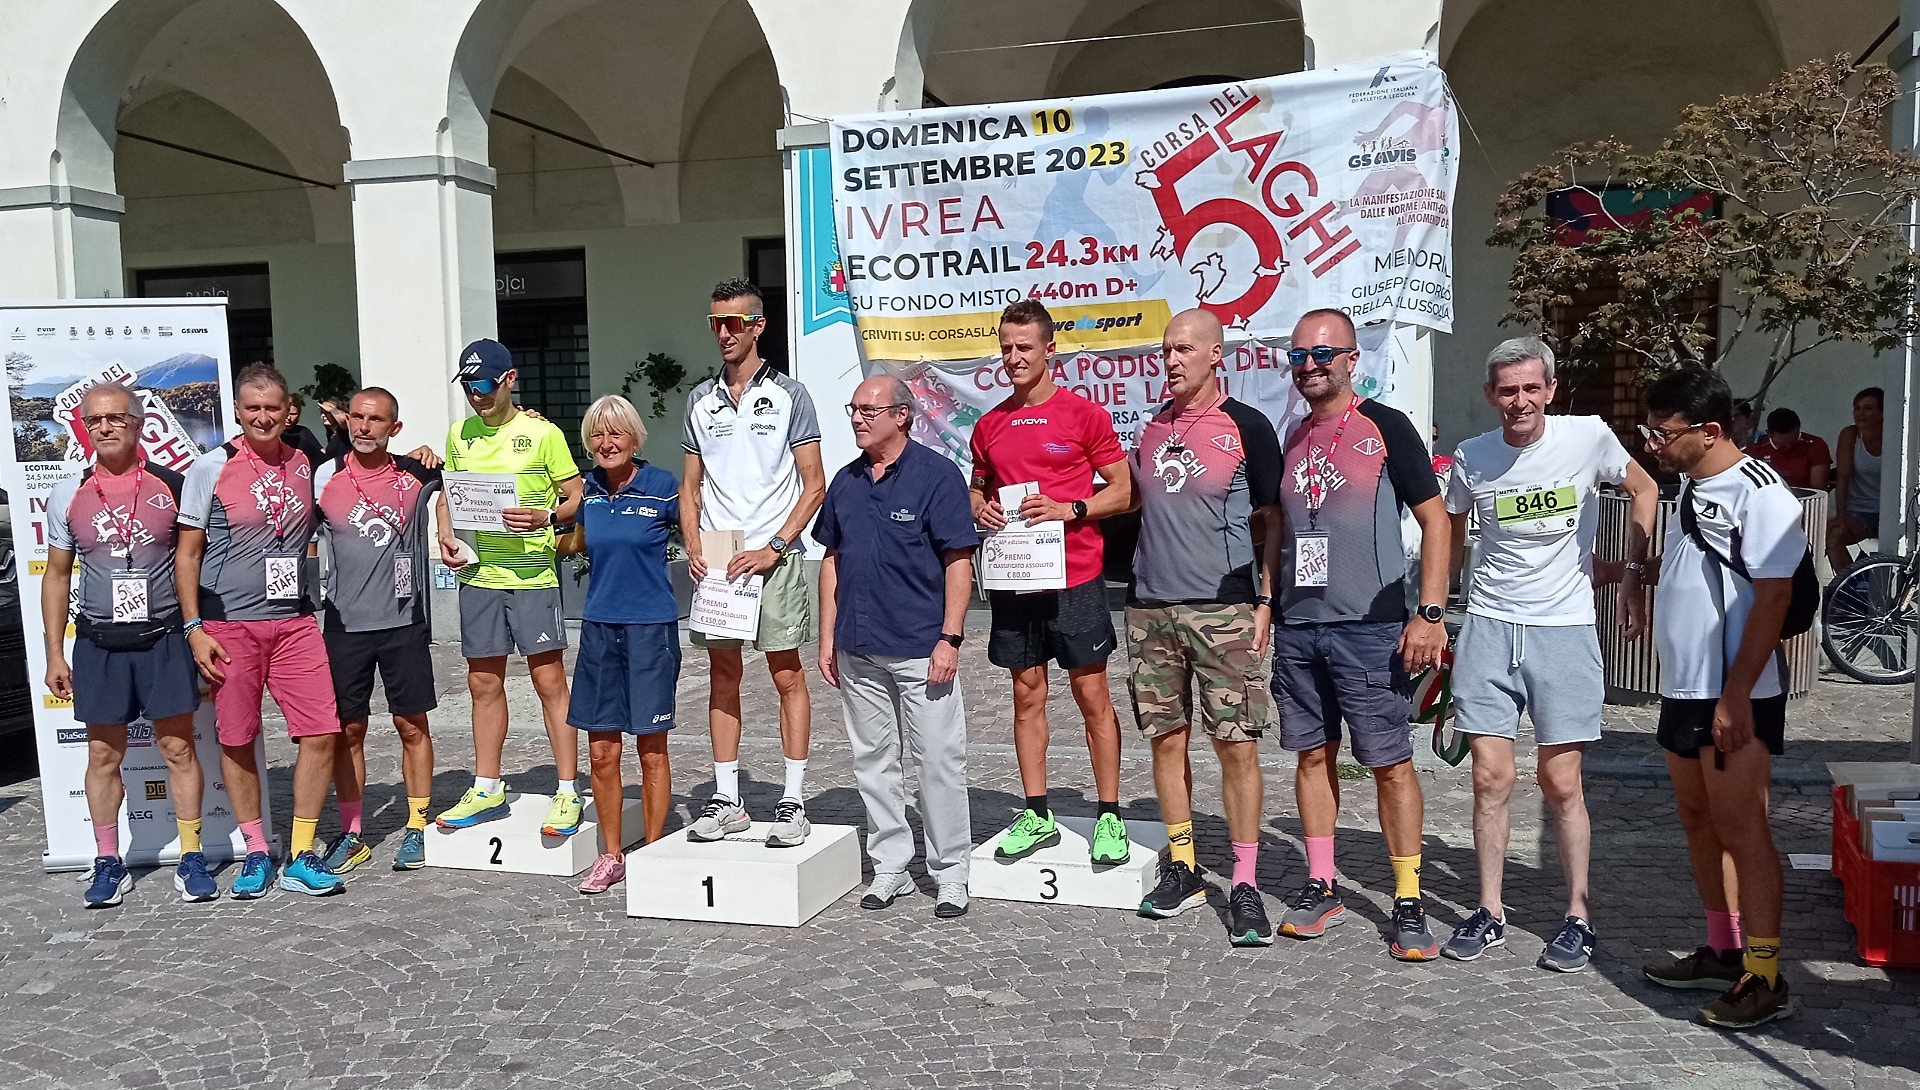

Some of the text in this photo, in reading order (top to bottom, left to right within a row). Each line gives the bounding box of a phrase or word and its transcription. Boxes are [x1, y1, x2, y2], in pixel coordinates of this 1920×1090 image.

[1349, 85, 1418, 98] FEDERAZIONE ITALIANA
[1358, 94, 1387, 103] ATLETICA
[1387, 91, 1416, 99] LEGGERA
[842, 108, 1072, 154] DOMENICA 10
[1140, 84, 1249, 169] CORSA DEI
[844, 141, 1127, 193] SETTEMBRE 2023
[1348, 148, 1417, 168] GS AVIS
[1213, 94, 1363, 279] LAGHI
[1350, 198, 1360, 208] LA
[1362, 188, 1435, 206] MANIFESTAZIONE
[846, 194, 1005, 240] IVREA
[1360, 207, 1386, 219] DALLE
[1388, 202, 1418, 216] NORME
[1396, 217, 1405, 227] AL
[848, 245, 1021, 281] ECOTRAIL
[852, 277, 1139, 312] SU FONDO MISTO 440m D+
[904, 330, 926, 342] SU:
[928, 326, 1000, 341] CORSA5LA
[1236, 347, 1279, 372] DEI
[102, 363, 126, 382] DEI
[1011, 418, 1048, 427] GIVOVA
[511, 438, 532, 449] TRR
[25, 464, 62, 472] ECOTRAIL
[25, 473, 41, 481] 24,5
[26, 482, 36, 490] SU
[1516, 491, 1558, 513] 846
[1004, 553, 1031, 561] PREMIO
[1012, 571, 1031, 579] 80,00
[1297, 553, 1327, 582] STAFF
[267, 571, 297, 595] STAFF
[114, 593, 147, 618] STAFF
[702, 598, 728, 609] PREMIO
[705, 617, 727, 626] 150,00
[720, 611, 748, 620] ASSOLUTO
[58, 731, 88, 740] DiaSor
[128, 810, 154, 820] AEG
[489, 837, 503, 865] 2
[702, 876, 715, 908] 1
[1039, 868, 1059, 900] 3
